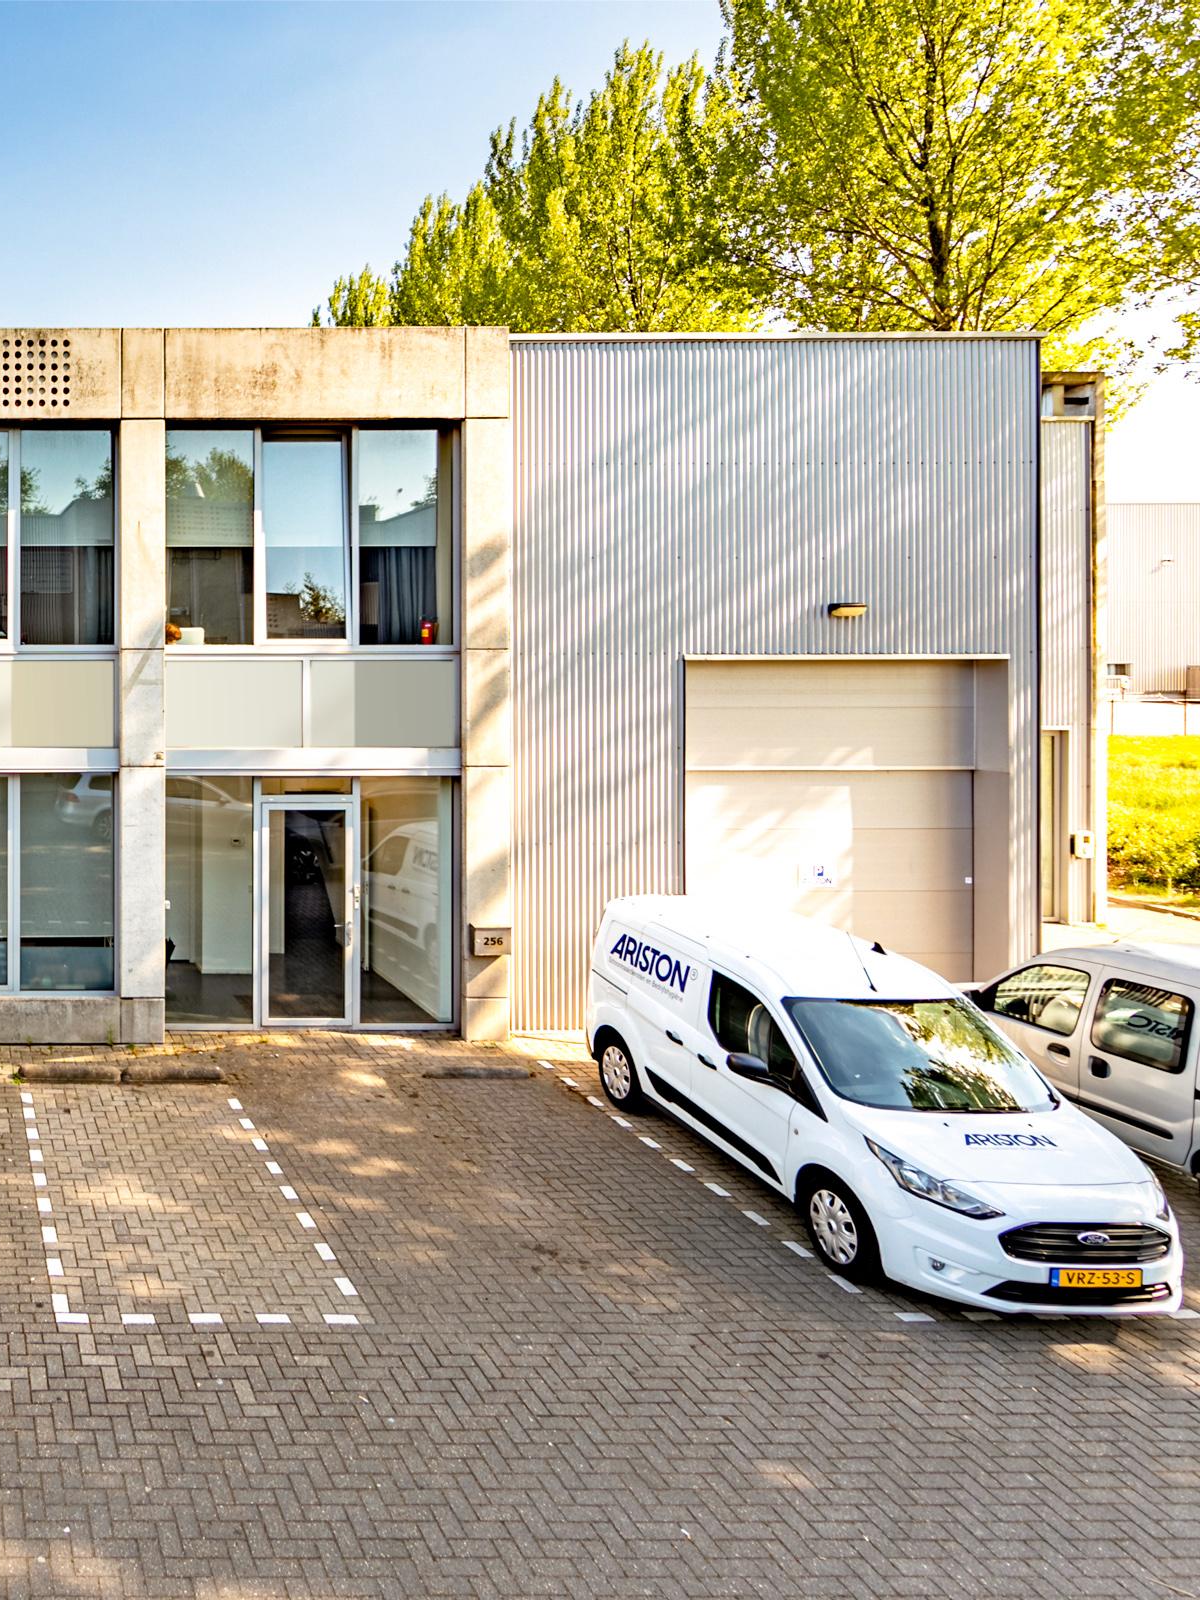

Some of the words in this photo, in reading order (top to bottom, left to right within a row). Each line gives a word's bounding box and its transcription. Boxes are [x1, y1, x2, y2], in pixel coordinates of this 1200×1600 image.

[483, 937, 504, 946] 256
[610, 933, 691, 993] ARISTON
[964, 1133, 1058, 1148] ARISTON
[1066, 1271, 1135, 1285] VRZ-53-S
